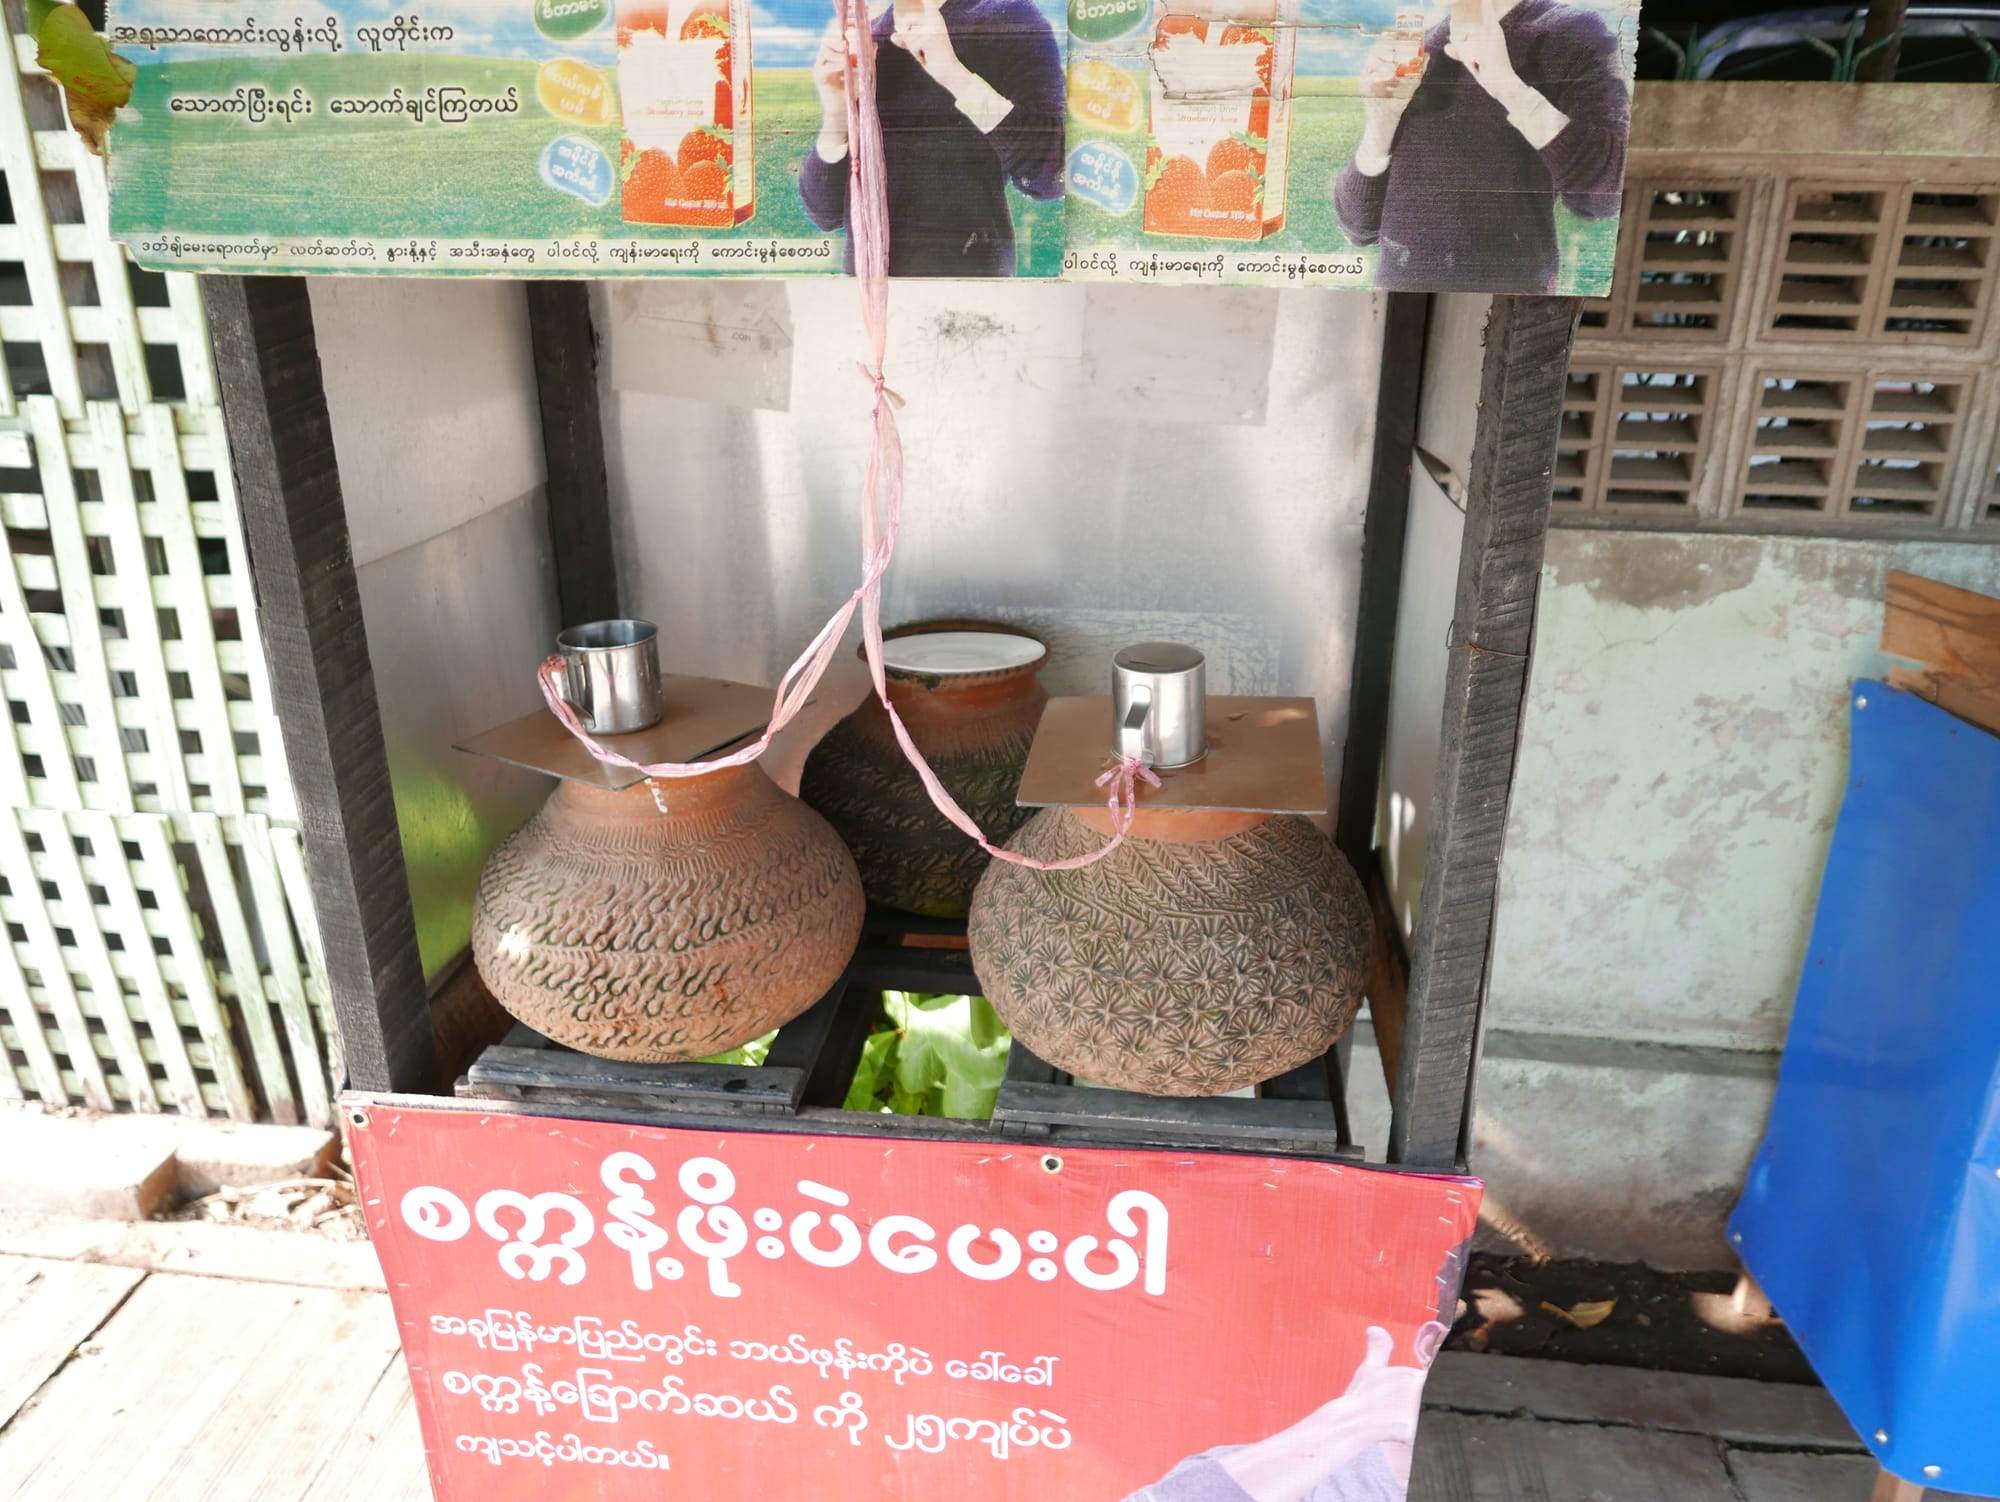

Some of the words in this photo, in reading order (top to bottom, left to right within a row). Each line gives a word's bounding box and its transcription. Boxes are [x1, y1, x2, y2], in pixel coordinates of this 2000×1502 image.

[114, 17, 342, 53] အရသာကောင်းလွန်းလို့
[357, 15, 454, 52] လူတိုင်းက
[169, 88, 312, 123] သောက်ပြီးရင်း
[330, 87, 519, 123] သောက်ချင်ကြတယ်
[609, 240, 700, 264] ကျန်းမာရေးကို
[711, 239, 831, 264] ကောင်းမွန်စေတယ်
[1129, 254, 1225, 279] ကျန်းမာရေးကို
[1236, 255, 1364, 280] ကောင်းမွန်စေတယ်
[429, 1308, 717, 1365] အခုမြန်မာပြည်တွင်း
[729, 1333, 934, 1386] ဘယ်ဖုန်းကိုပဲ
[945, 1351, 1061, 1387] ခေါ်ခေါ်
[813, 1391, 869, 1447] ကို
[884, 1407, 1073, 1460] ၂၅ကျပ်ပဲ
